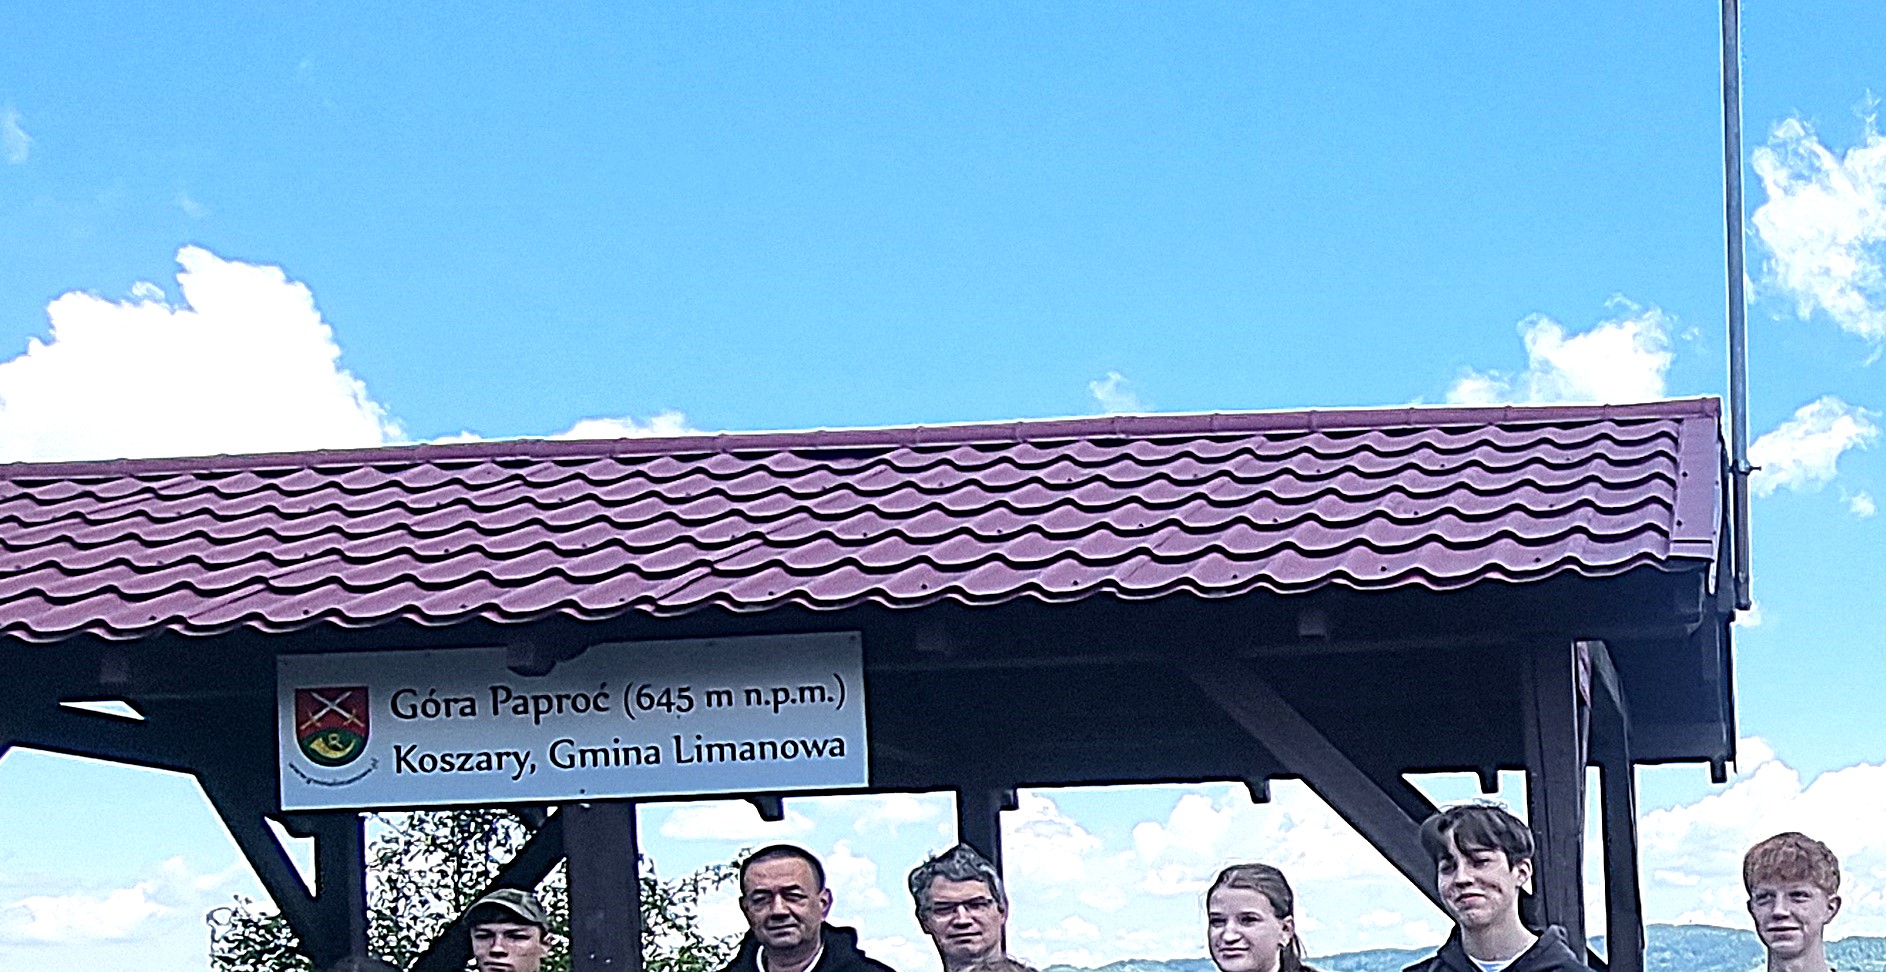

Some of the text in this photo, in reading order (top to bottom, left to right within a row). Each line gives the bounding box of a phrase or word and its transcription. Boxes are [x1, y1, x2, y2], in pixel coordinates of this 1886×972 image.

[390, 672, 846, 726] Góra Paproć (645 m n.p.m.)
[393, 744, 536, 781] Koszary,
[549, 738, 661, 769] Gmina
[673, 733, 846, 764] Limanowa
